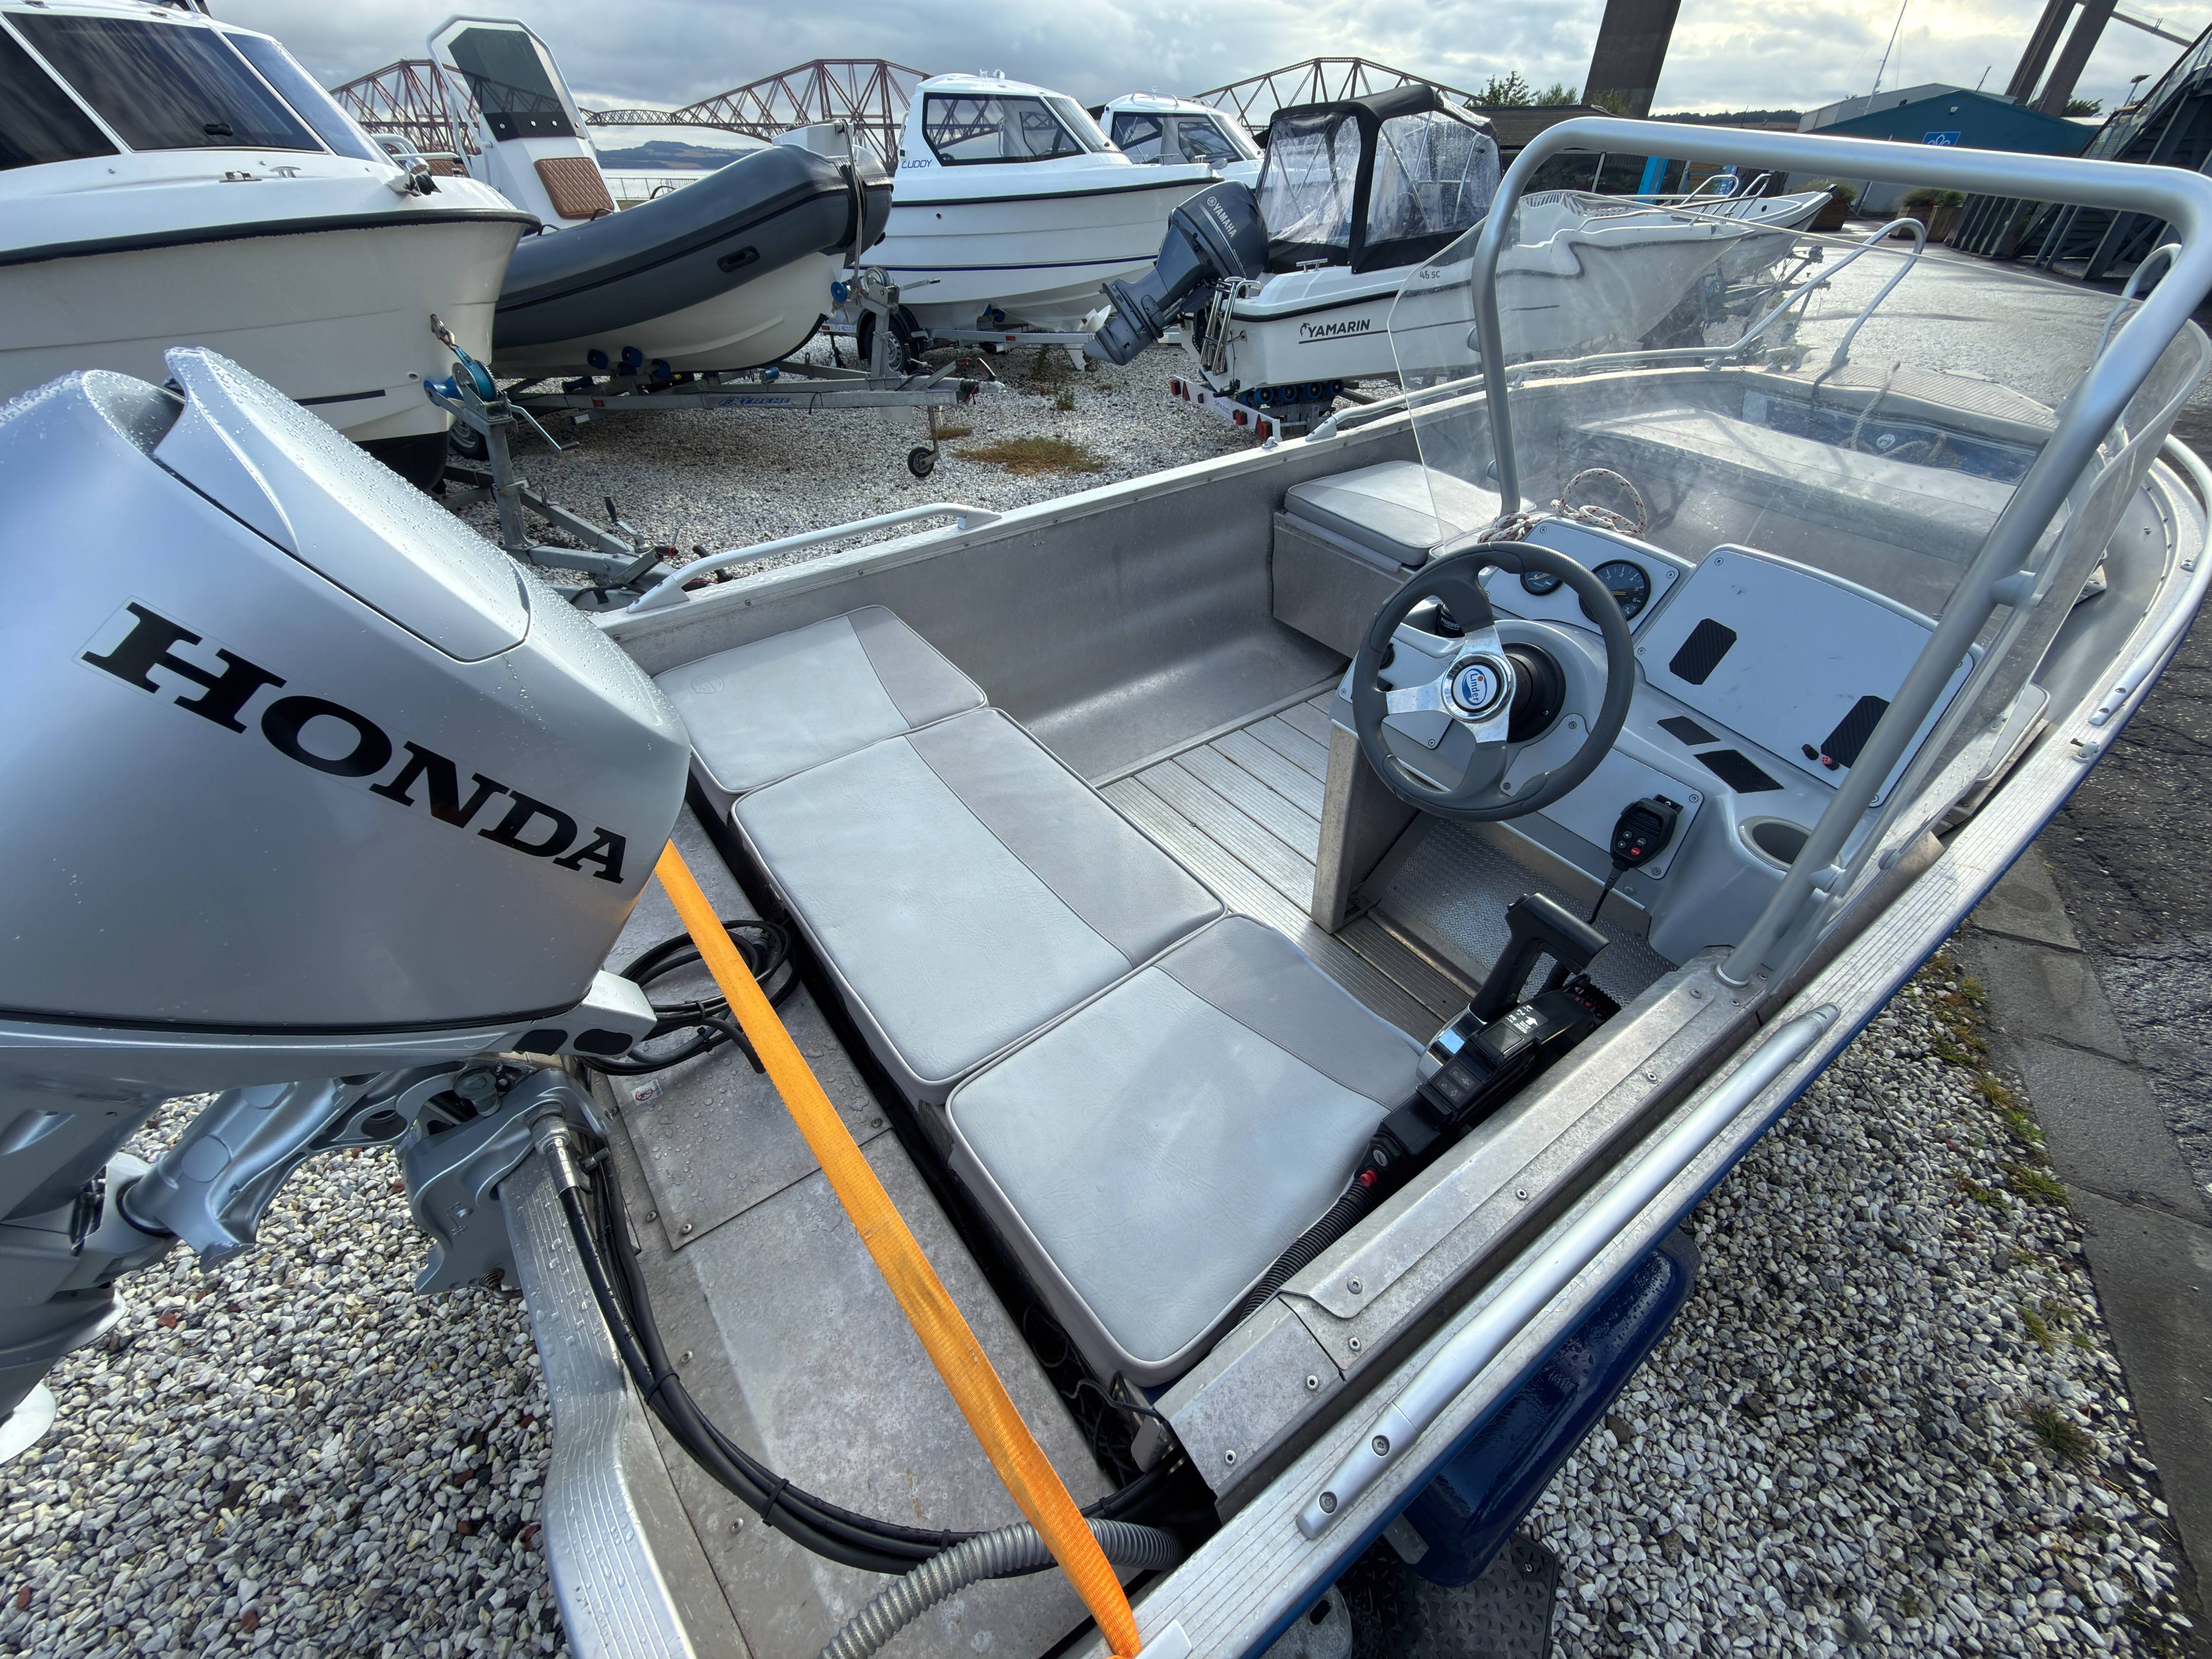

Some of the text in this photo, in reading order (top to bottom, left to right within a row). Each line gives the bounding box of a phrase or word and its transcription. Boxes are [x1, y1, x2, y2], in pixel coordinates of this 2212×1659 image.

[902, 159, 932, 168] CUDDY
[1213, 203, 1237, 238] YAMAHA
[1419, 270, 1429, 279] 46
[1308, 319, 1371, 338] YAMARIN
[1470, 673, 1482, 702] Linder
[81, 601, 627, 884] HONDA
